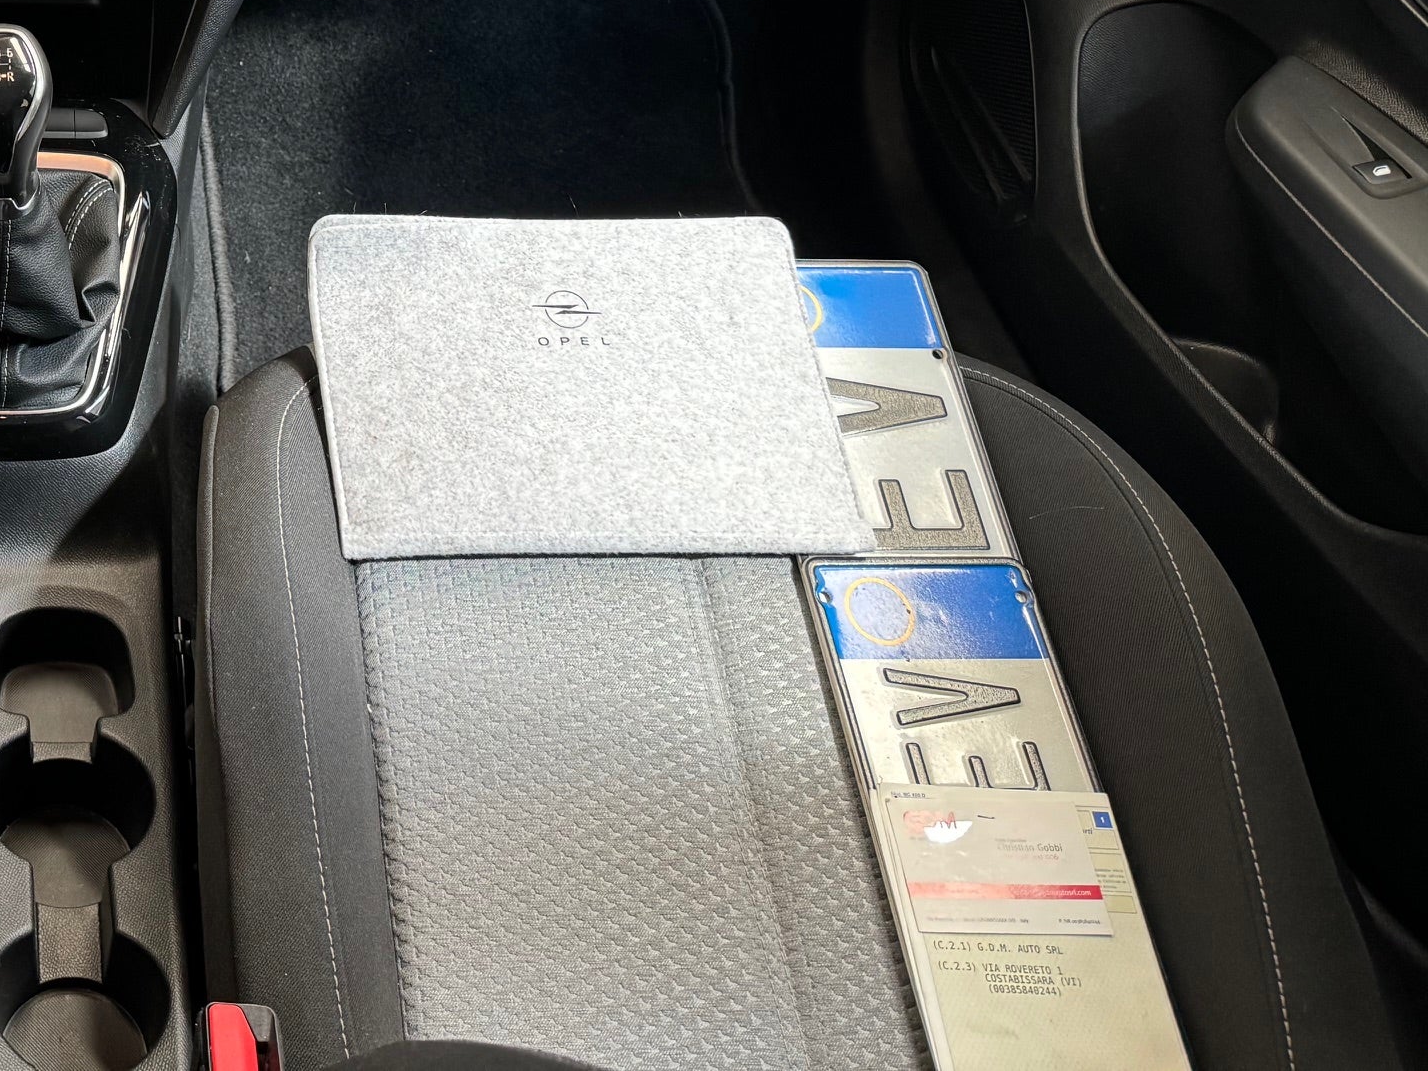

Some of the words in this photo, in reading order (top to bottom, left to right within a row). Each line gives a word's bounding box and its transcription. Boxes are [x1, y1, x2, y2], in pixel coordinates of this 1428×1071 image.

[6, 47, 14, 58] 5
[7, 71, 15, 82] R
[537, 336, 611, 347] OPEL
[1037, 843, 1063, 853] Gobbi
[977, 942, 1011, 953] G.D.M.
[1018, 944, 1041, 954] AUTO
[1046, 945, 1064, 955] SRL
[938, 961, 976, 973] (C.2.3)
[982, 963, 1001, 973] VIA
[1005, 964, 1052, 975] ROVERETO
[985, 973, 1055, 986] COSTABISSARA
[1060, 977, 1082, 988] (VI)
